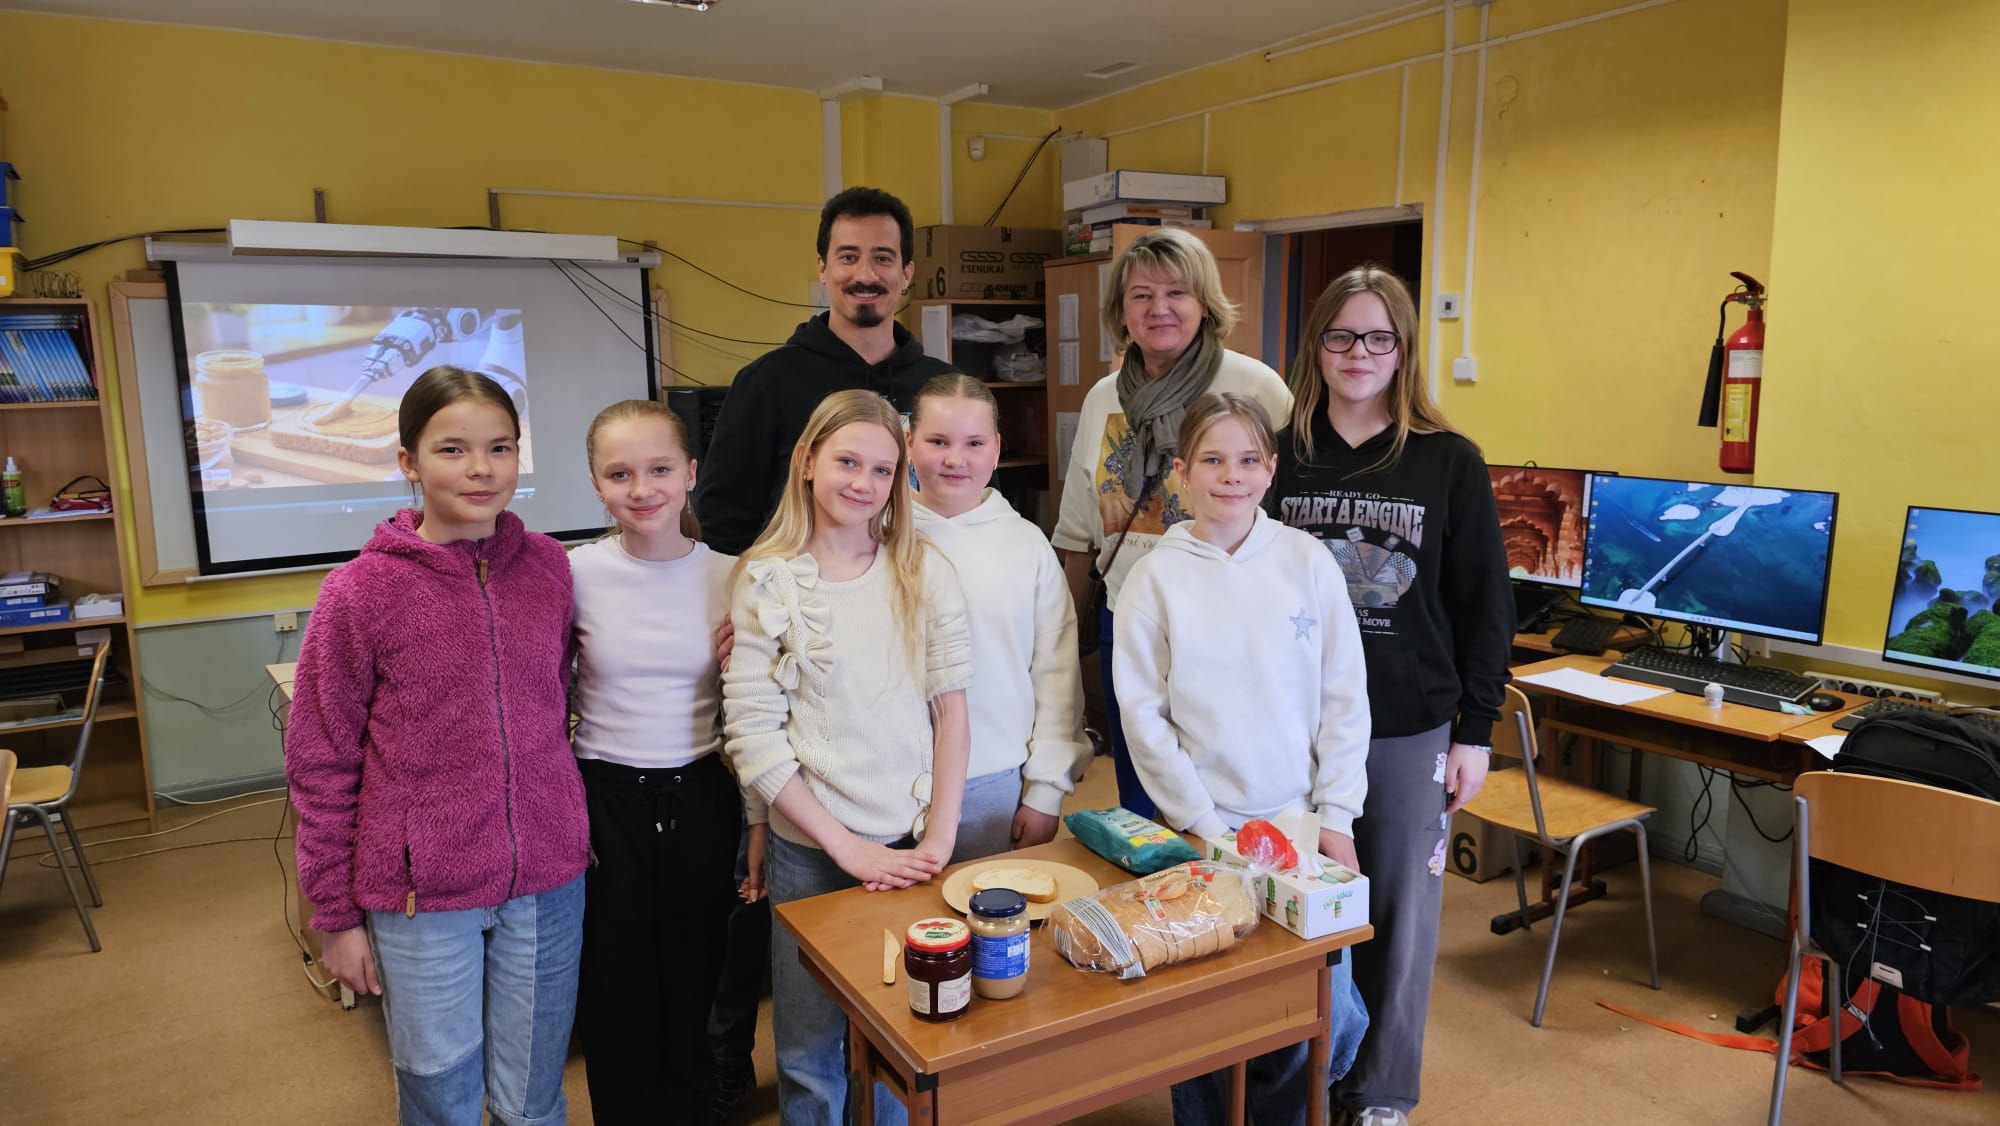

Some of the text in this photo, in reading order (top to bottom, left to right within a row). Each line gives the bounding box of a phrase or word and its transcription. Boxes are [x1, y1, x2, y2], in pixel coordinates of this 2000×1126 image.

[936, 266, 946, 297] 6
[1329, 490, 1361, 499] READY
[1281, 497, 1337, 526] START
[1336, 499, 1351, 524] A
[1352, 500, 1425, 550] ENGINE
[1362, 618, 1391, 627] MOVE
[1453, 832, 1477, 875] 6
